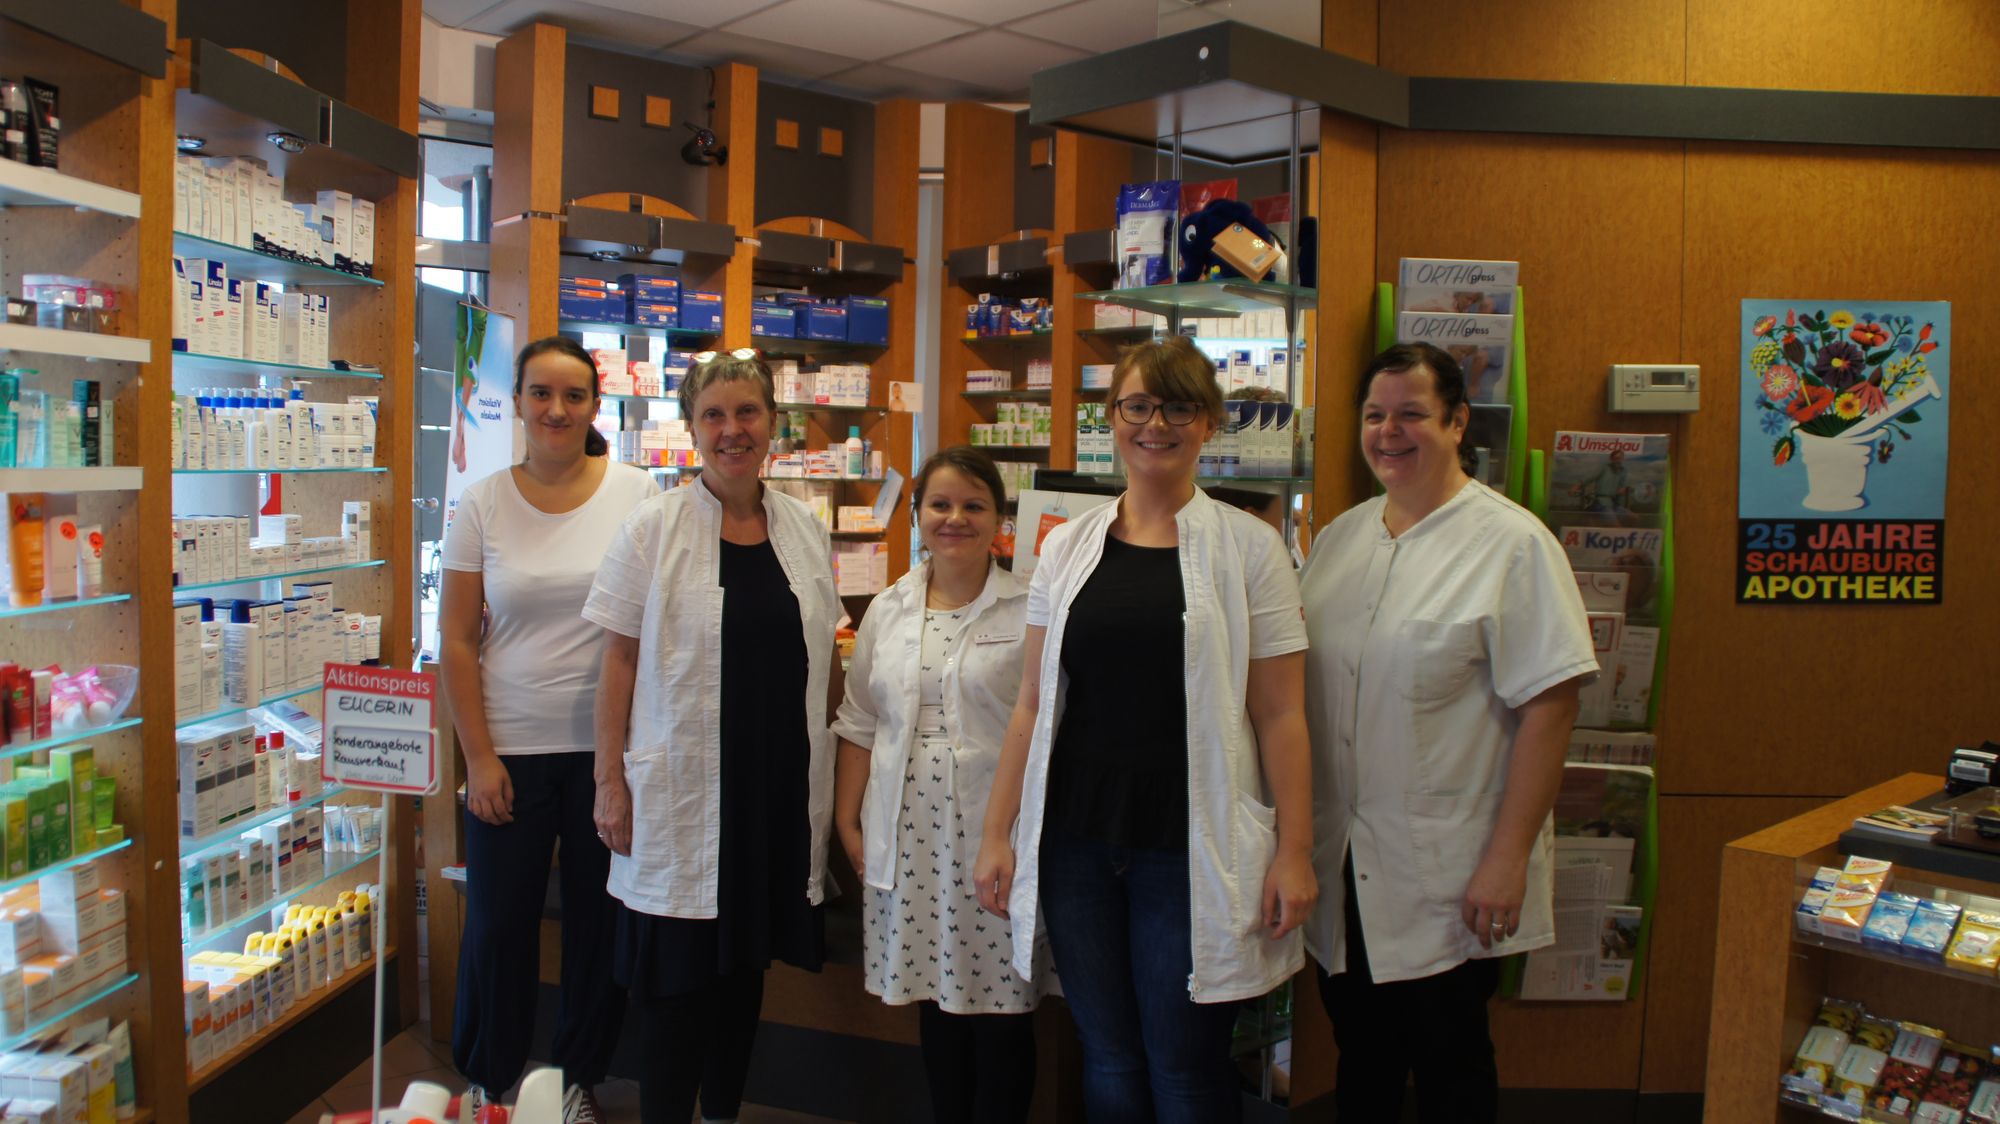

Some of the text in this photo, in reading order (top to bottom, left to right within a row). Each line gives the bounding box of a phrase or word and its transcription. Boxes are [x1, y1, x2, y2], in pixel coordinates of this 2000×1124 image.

[1577, 437, 1641, 452] Umschau
[1585, 531, 1639, 554] Kopf
[1746, 523, 1937, 550] 25 JAHRE
[1744, 551, 1936, 573] SCHAUBURG
[1743, 575, 1936, 600] APOTHEKE
[326, 667, 431, 695] Aktionspreis
[338, 695, 414, 715] EUCERIN
